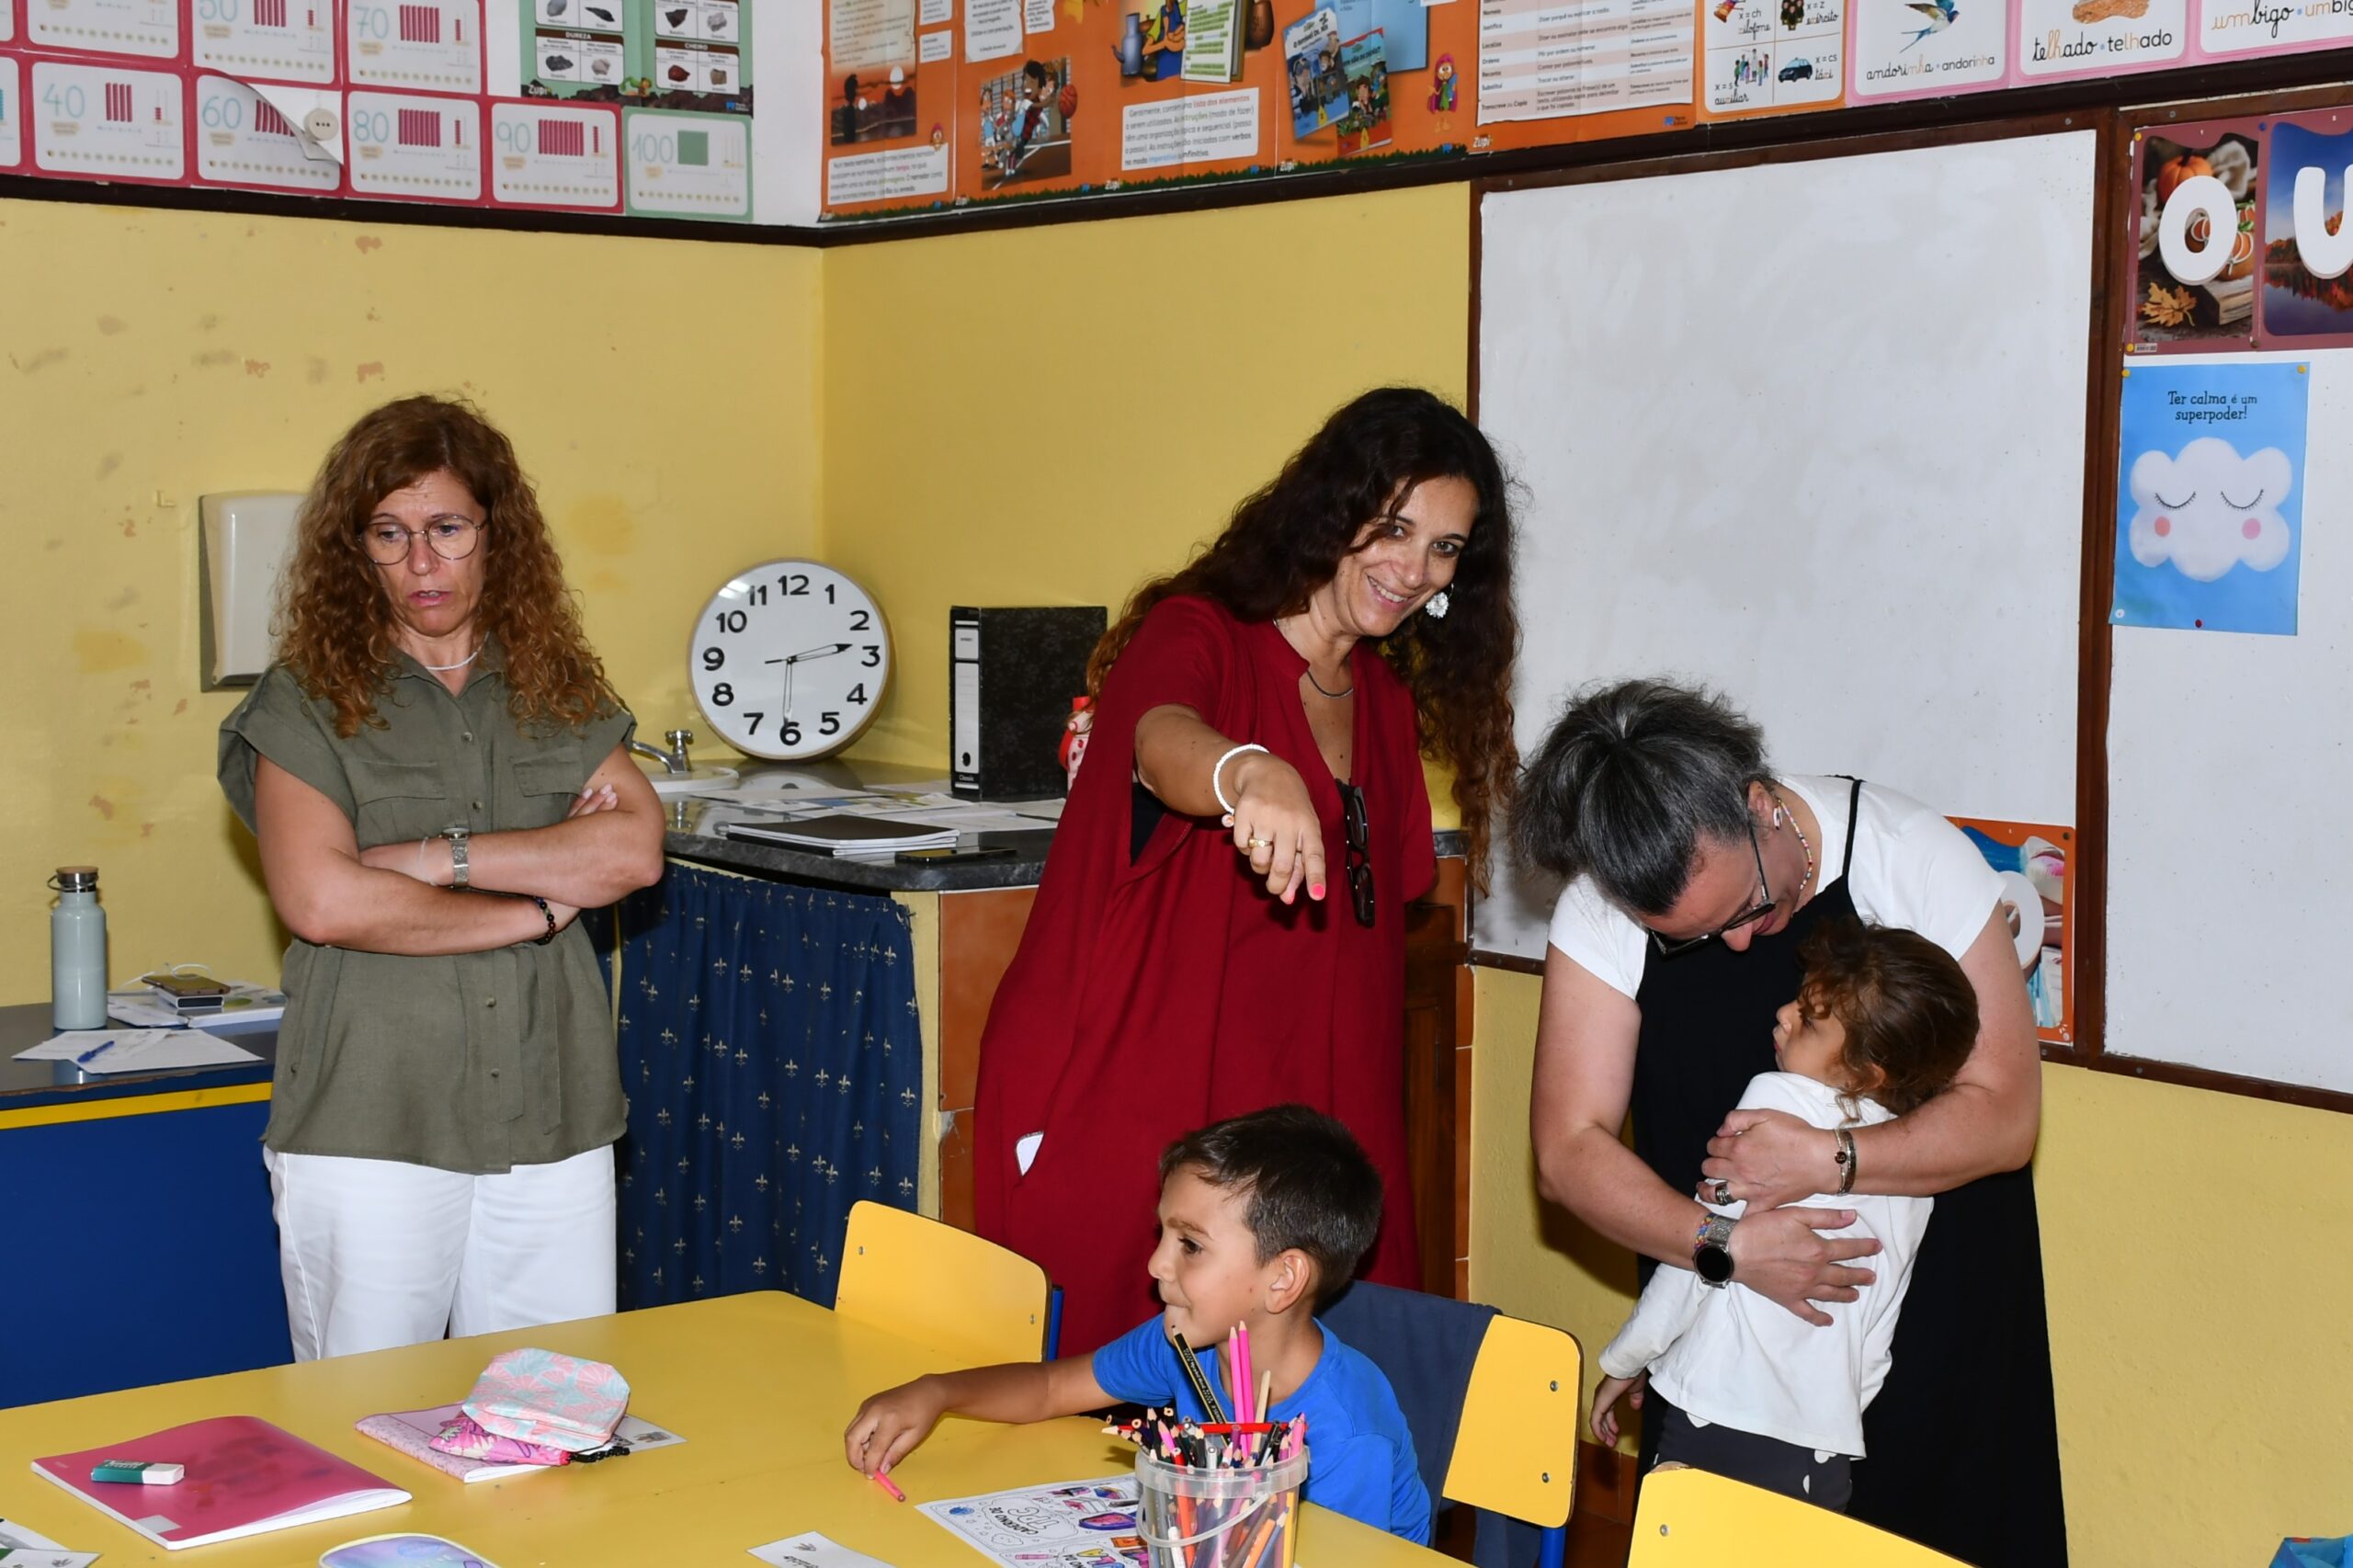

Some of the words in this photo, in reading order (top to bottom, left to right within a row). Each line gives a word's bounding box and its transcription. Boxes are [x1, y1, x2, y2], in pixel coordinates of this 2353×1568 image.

[353, 5, 389, 40] 70
[1751, 8, 1762, 18] ch
[2211, 0, 2294, 39] umbigo
[565, 31, 592, 40] DUREZA
[684, 42, 709, 51] CHEIRO
[2032, 29, 2097, 62] telhado
[2108, 29, 2172, 52] telhado
[1828, 54, 1837, 62] cs
[1866, 53, 1934, 81] andorinha
[1942, 53, 1995, 71] andorinha
[42, 83, 85, 119] 40
[201, 96, 243, 130] 60
[353, 109, 390, 143] 80
[494, 121, 531, 154] 90
[631, 133, 675, 164] 100
[1472, 135, 1491, 148] Zupi
[2167, 391, 2186, 405] Ter
[2190, 391, 2227, 405] calma
[2231, 393, 2238, 404] é
[2241, 395, 2257, 404] um
[2175, 405, 2248, 424] superpoder!
[747, 585, 767, 606] 11
[778, 574, 810, 596] 12
[824, 584, 835, 605] 1
[715, 610, 747, 633] 10
[849, 610, 870, 631] 2
[702, 647, 725, 671] 9
[860, 645, 881, 667] 3
[711, 683, 734, 707] 8
[847, 683, 868, 705] 4
[743, 712, 764, 735] 7
[779, 722, 801, 746] 6
[818, 711, 840, 735] 5
[995, 1513, 1040, 1536] CADERNO
